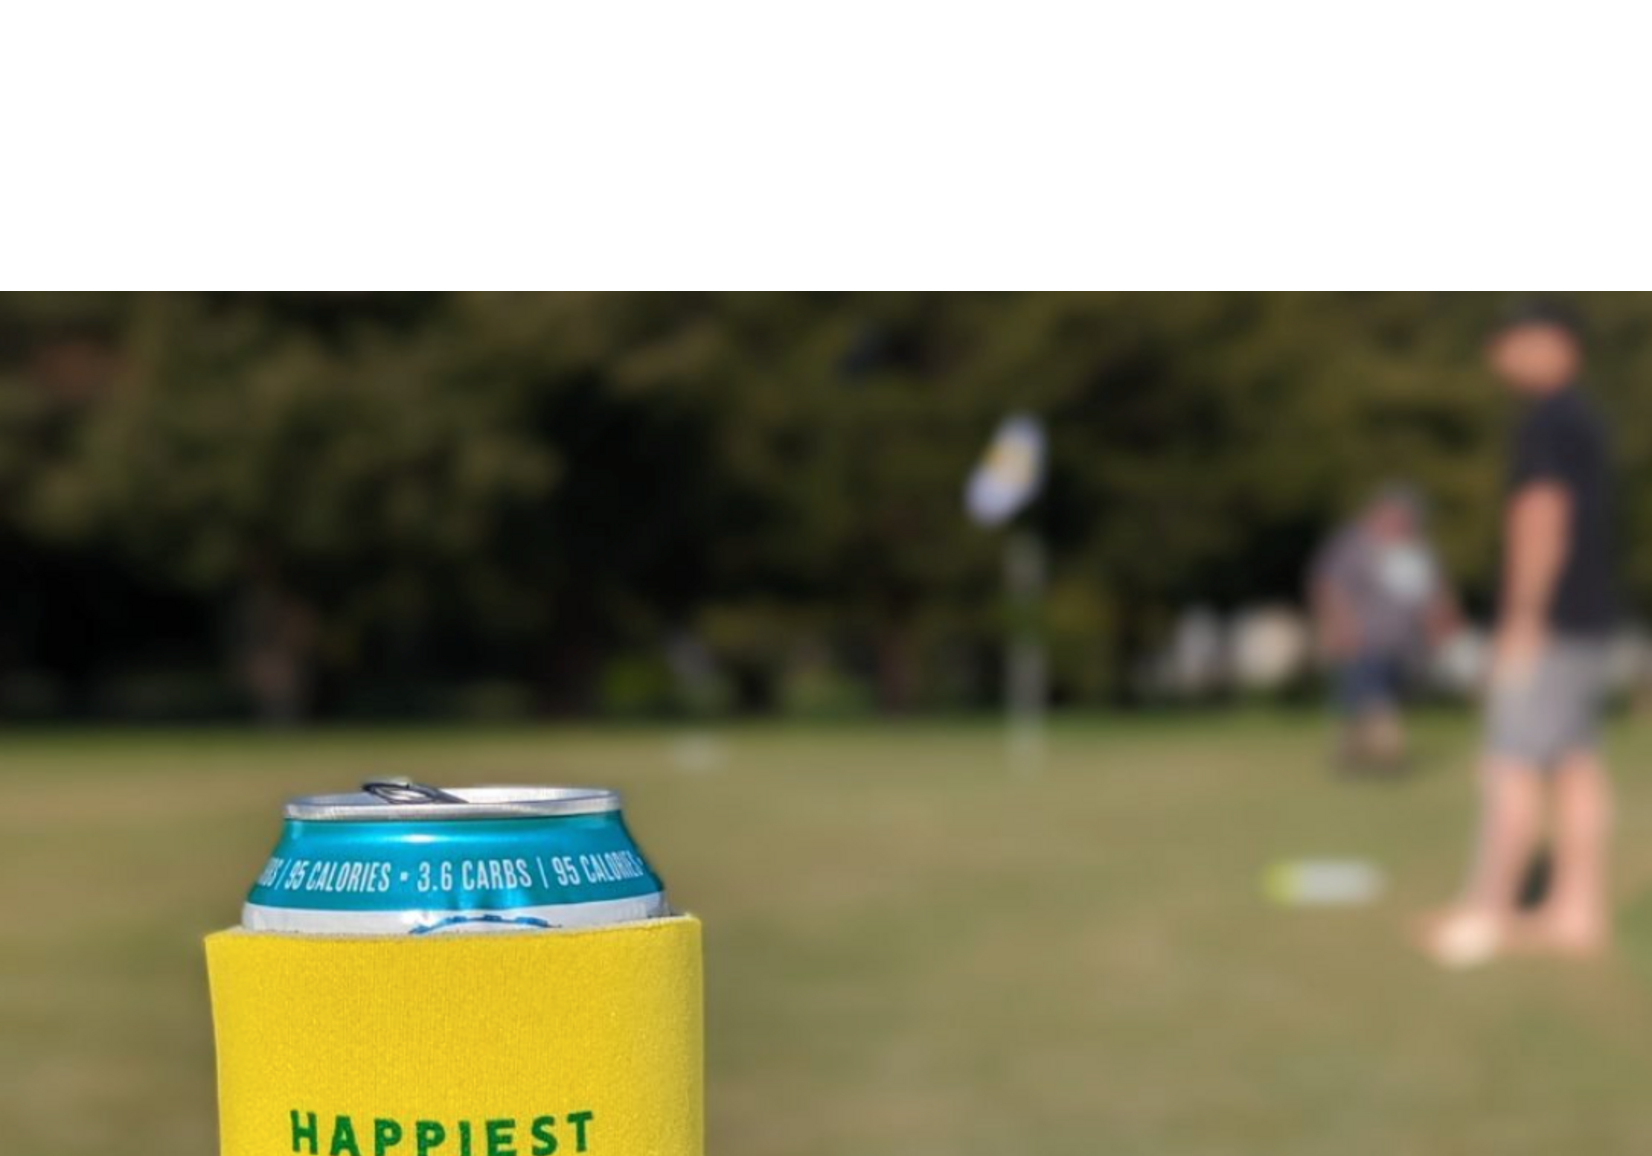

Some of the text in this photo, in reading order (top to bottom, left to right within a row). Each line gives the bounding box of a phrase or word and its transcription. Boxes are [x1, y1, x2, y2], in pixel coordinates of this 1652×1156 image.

[284, 859, 309, 891] 95
[305, 860, 392, 892] CALORIES
[417, 861, 452, 892] 3.6
[461, 858, 532, 891] CARBS
[551, 856, 581, 886] 95
